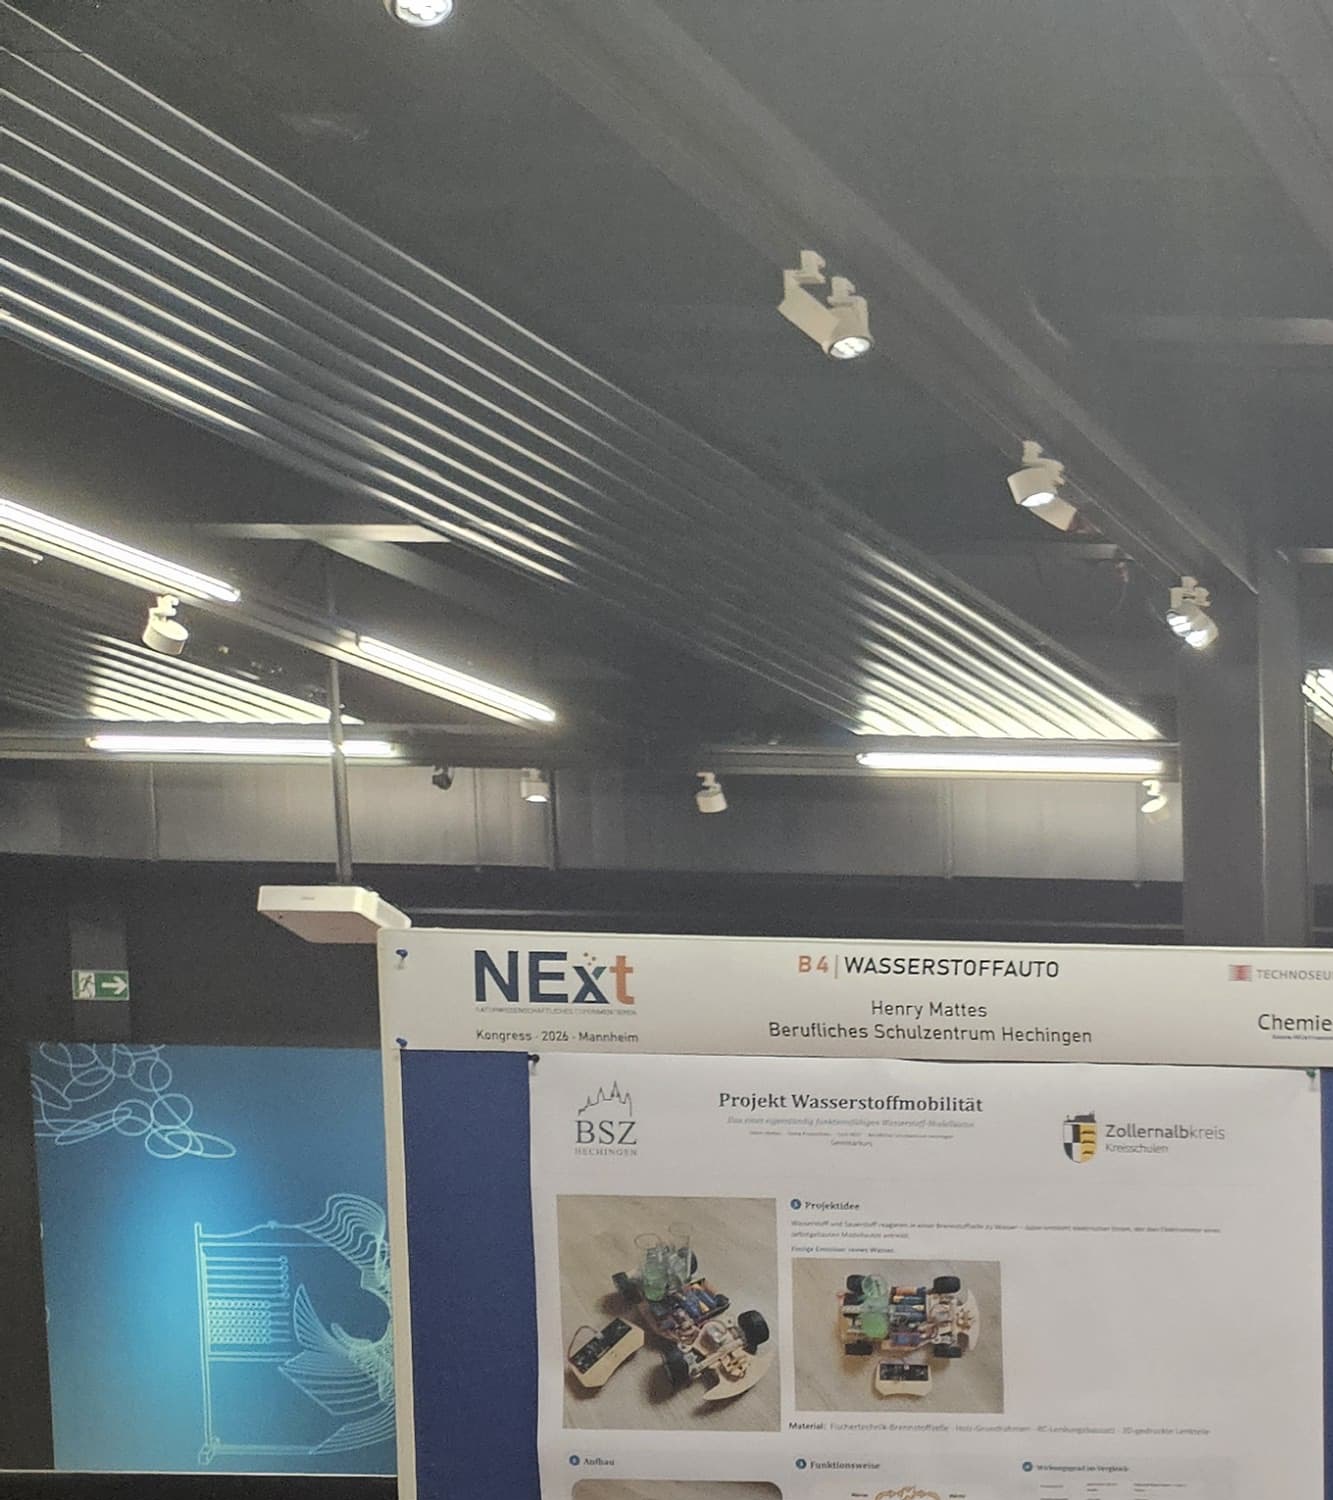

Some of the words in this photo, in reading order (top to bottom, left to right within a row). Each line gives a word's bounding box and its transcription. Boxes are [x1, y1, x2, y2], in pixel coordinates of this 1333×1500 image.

[845, 956, 1060, 978] WASSERSTOFFAUTO
[474, 950, 635, 1004] NExt
[871, 1001, 923, 1020] Henry
[929, 1002, 988, 1018] Mattes
[476, 1030, 532, 1043] Kongress
[541, 1031, 569, 1042] 2026
[578, 1032, 639, 1043] Mannheim
[768, 1022, 868, 1039] Berufliches
[874, 1024, 996, 1041] Schulzentrum
[1001, 1026, 1092, 1046] Hechingen
[719, 1093, 787, 1111] Projekt
[791, 1094, 984, 1112] Wasserstoffmobilität
[576, 1120, 637, 1144] BSZ
[1105, 1123, 1225, 1140] Zollernalbkreis
[805, 1201, 860, 1212] Projektidee
[810, 1461, 880, 1470] Funktionsweise
